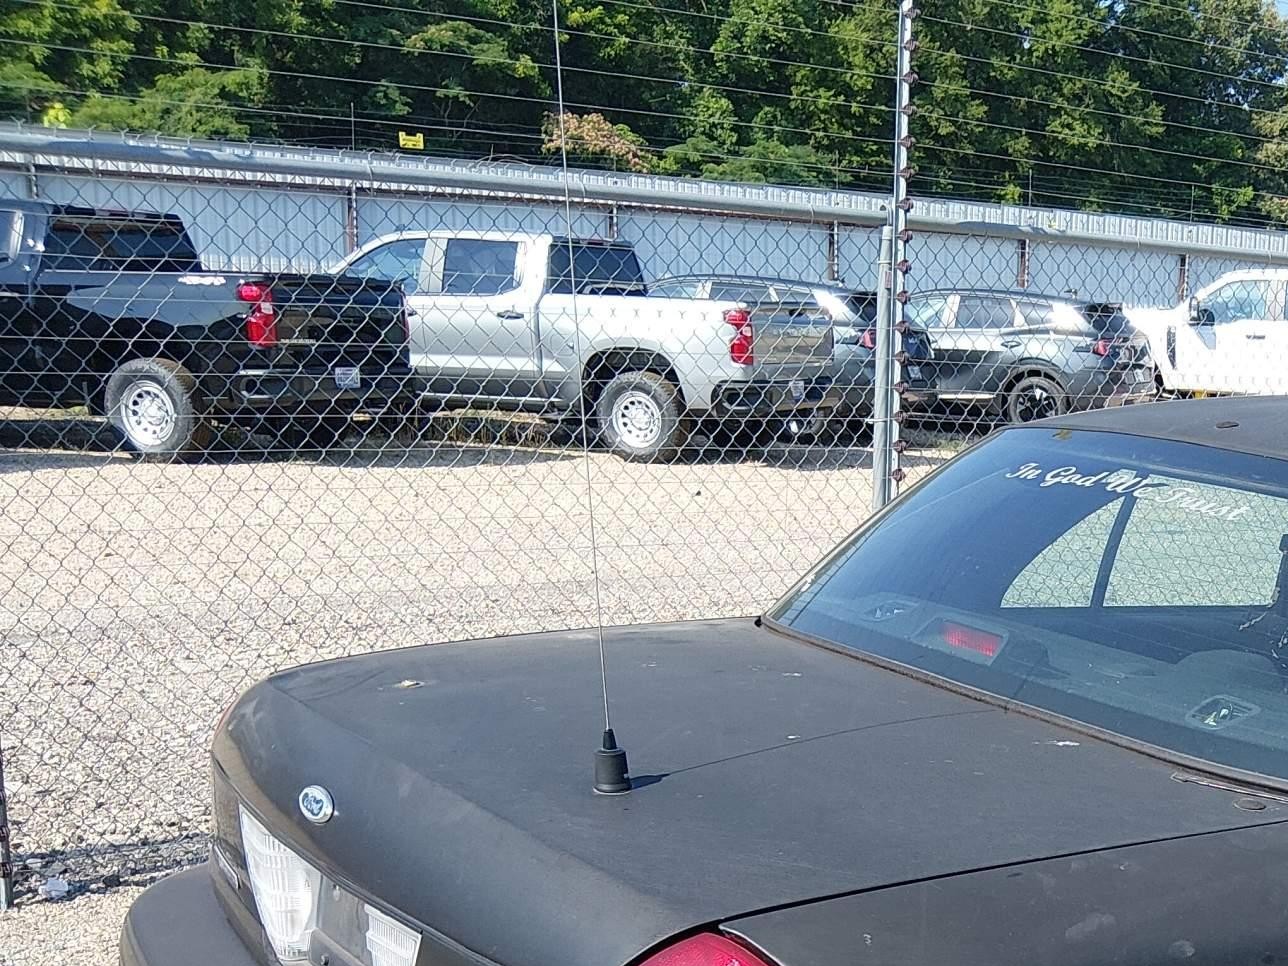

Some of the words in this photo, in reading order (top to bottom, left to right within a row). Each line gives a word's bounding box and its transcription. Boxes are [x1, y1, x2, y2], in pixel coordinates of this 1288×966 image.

[1005, 462, 1042, 479] In
[1039, 466, 1110, 488] God
[1102, 475, 1153, 494] We
[1156, 487, 1250, 520] Trust
